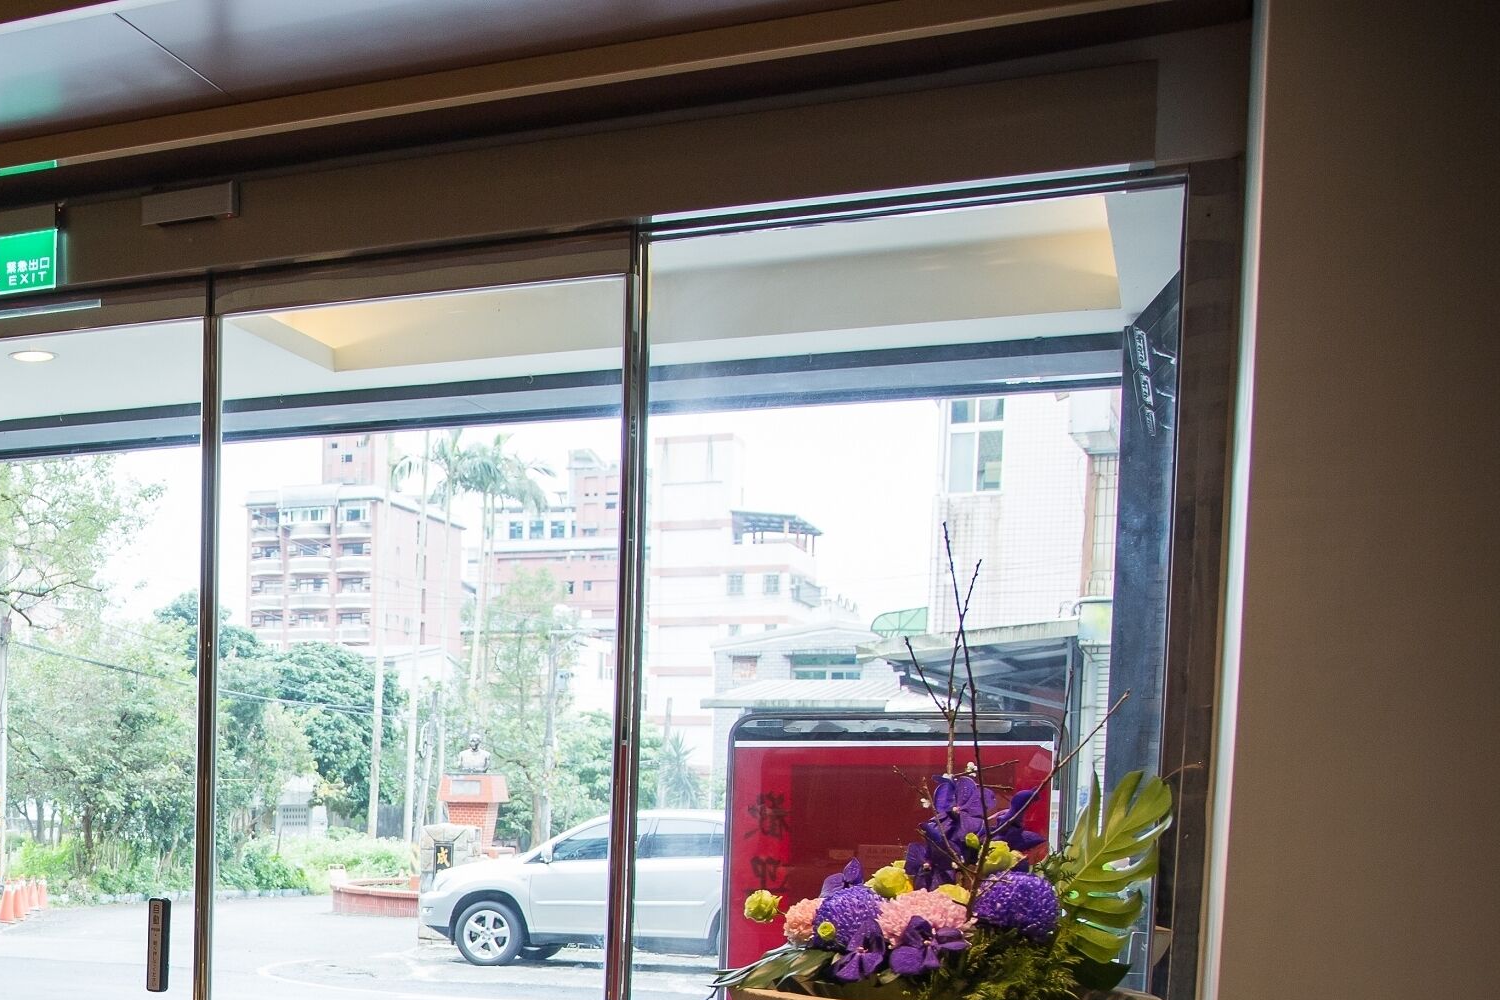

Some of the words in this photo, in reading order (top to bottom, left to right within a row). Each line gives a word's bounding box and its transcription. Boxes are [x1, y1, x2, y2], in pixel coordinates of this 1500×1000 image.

[6, 257, 50, 275] 緊急出口
[8, 271, 48, 286] EXIT
